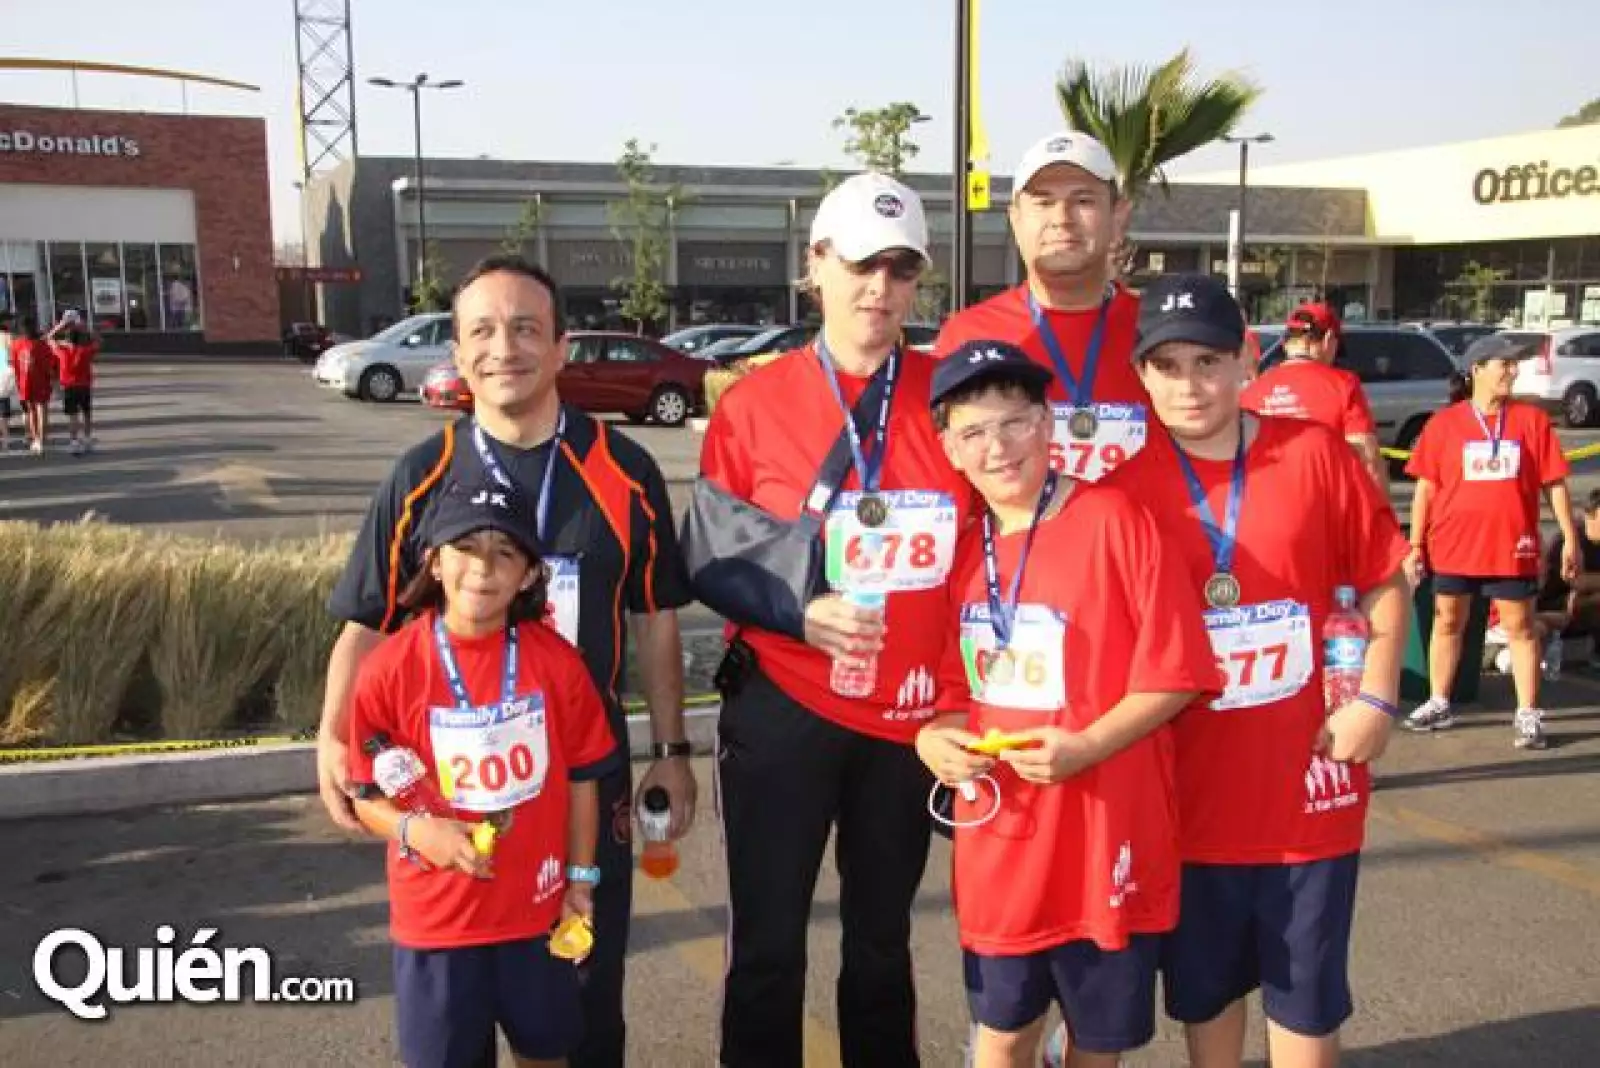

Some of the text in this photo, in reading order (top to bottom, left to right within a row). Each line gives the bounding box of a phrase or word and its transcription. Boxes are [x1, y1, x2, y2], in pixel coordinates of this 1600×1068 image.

[1474, 159, 1598, 205] Office
[845, 533, 936, 569] 678
[451, 743, 534, 791] 200
